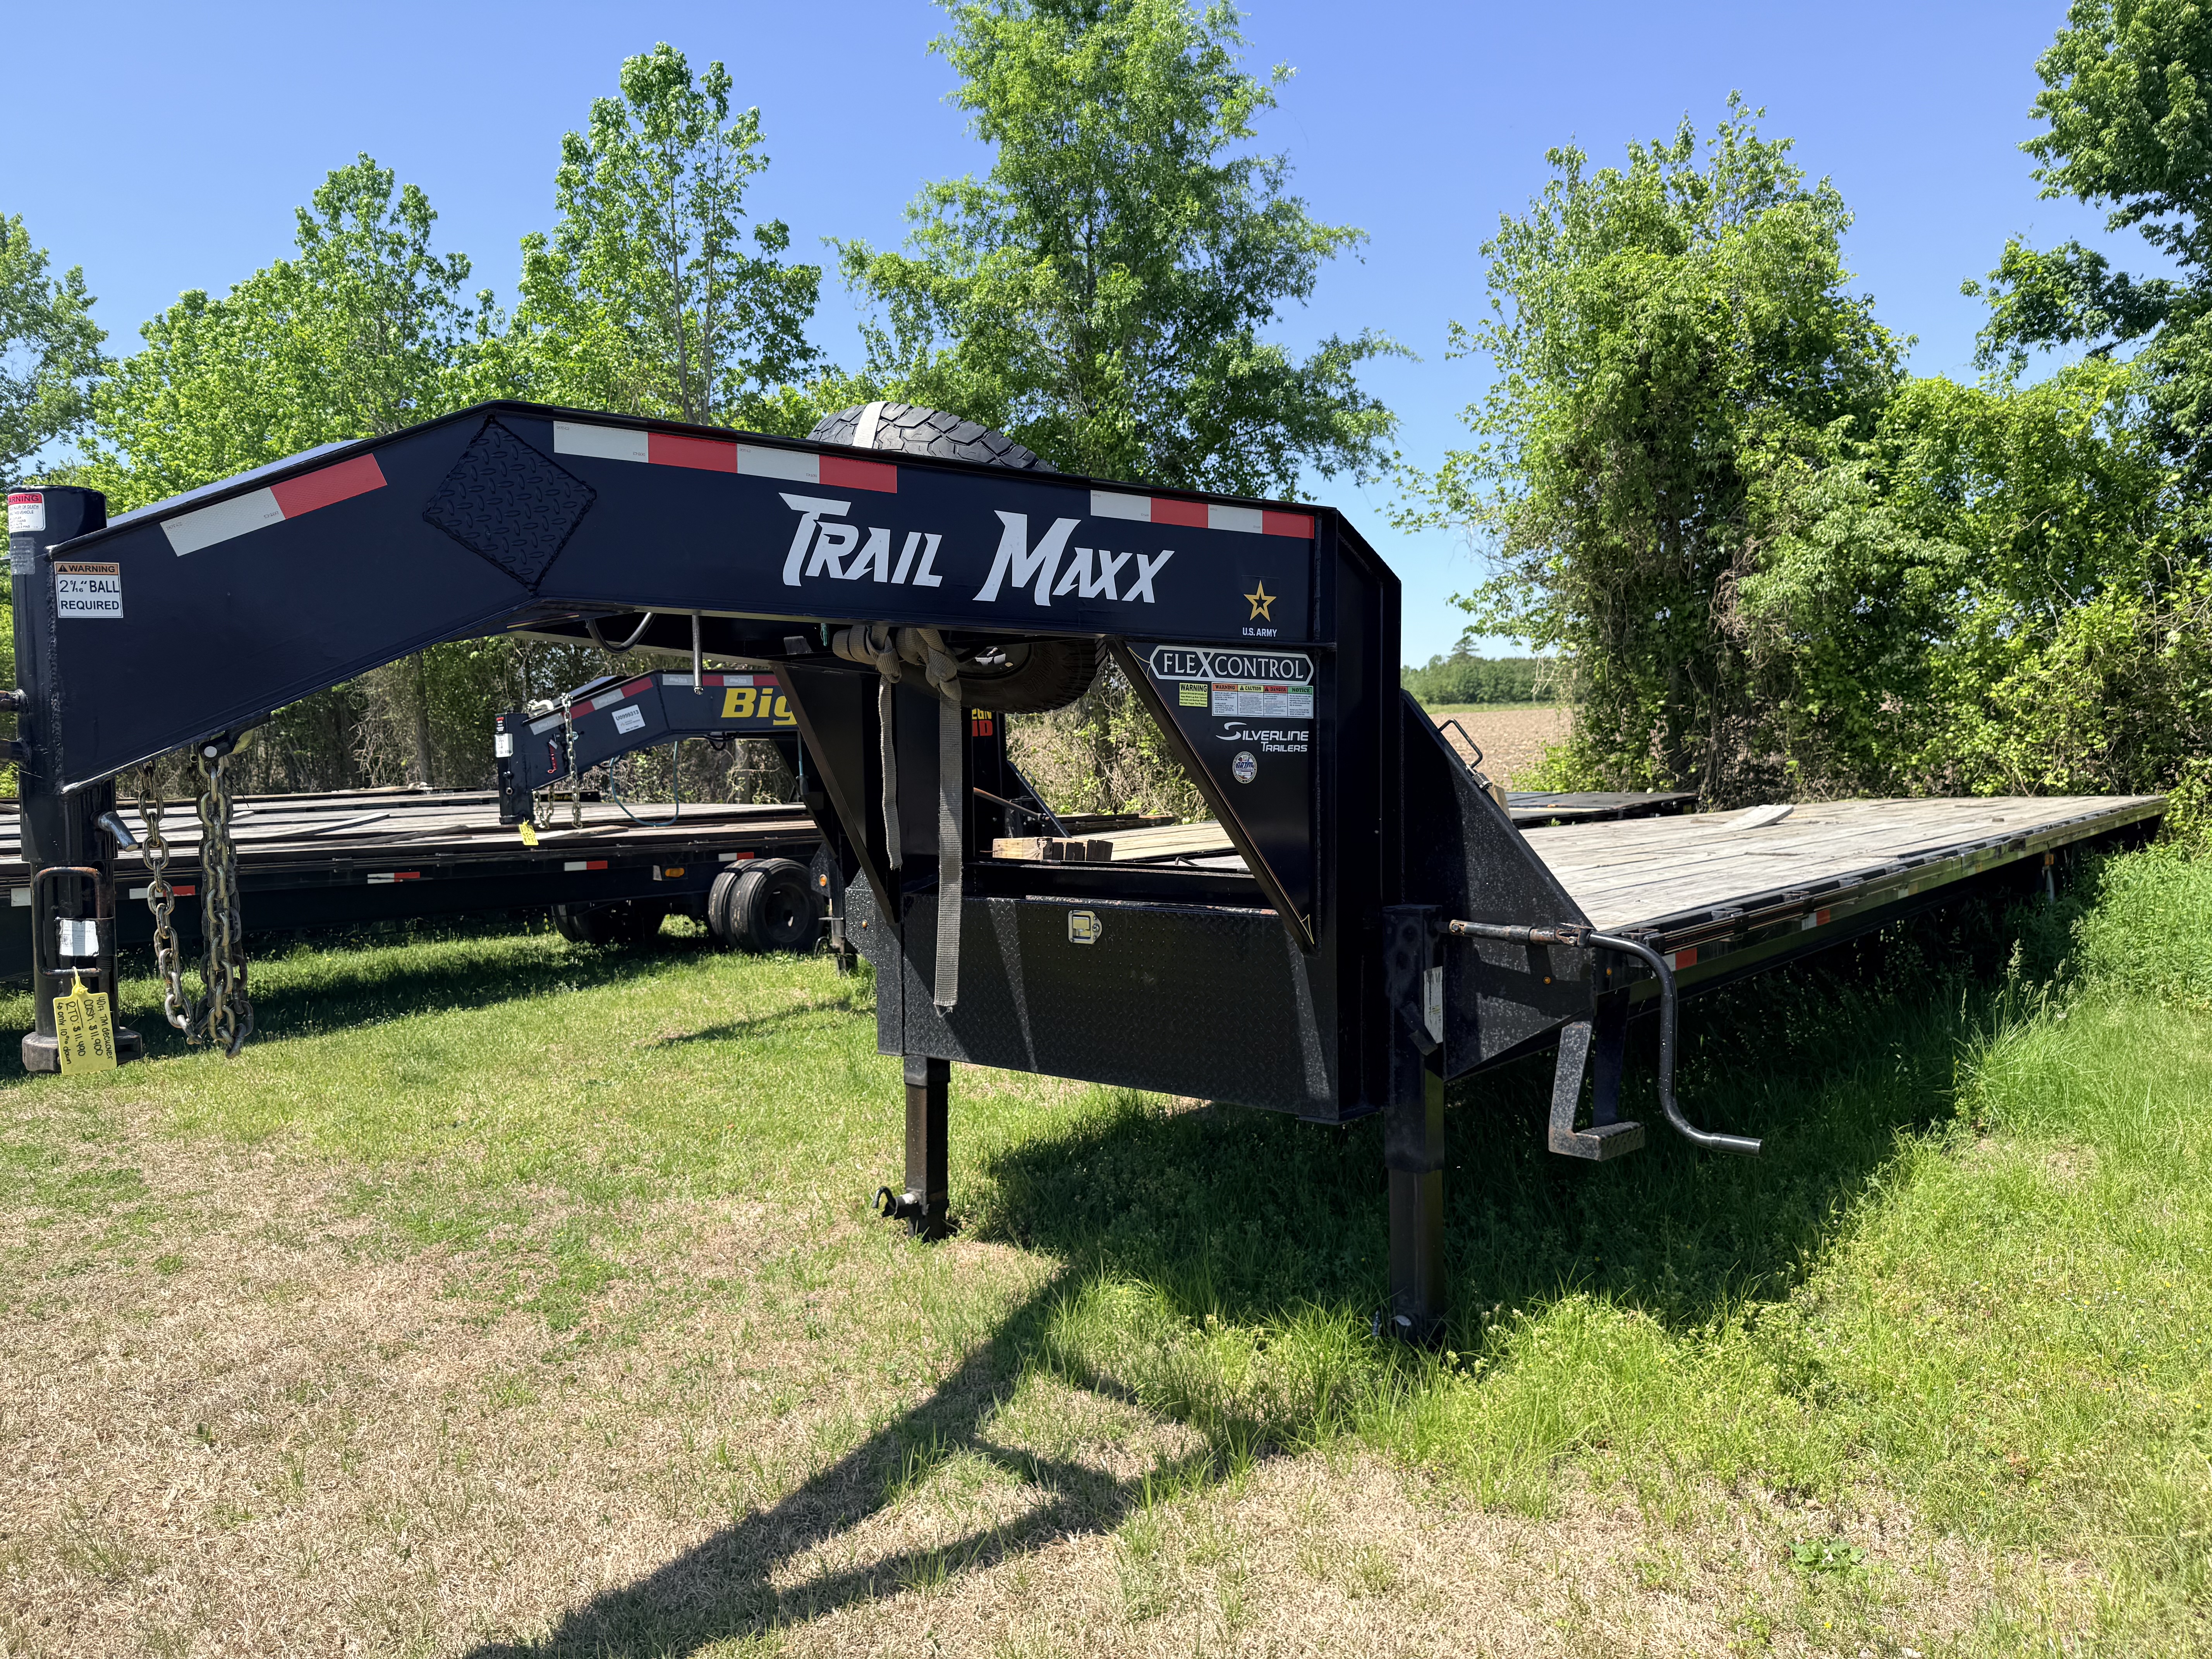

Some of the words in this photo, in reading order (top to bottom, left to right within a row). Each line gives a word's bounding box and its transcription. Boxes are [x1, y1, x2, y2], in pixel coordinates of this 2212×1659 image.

[9, 495, 39, 503] ARNING
[778, 493, 943, 587] TRAIL
[972, 510, 1175, 606] MAXX
[89, 580, 119, 592] BALL
[61, 600, 119, 610] REQUIRED
[1242, 627, 1255, 636] U.S.
[1256, 628, 1277, 637] ARMY
[1180, 684, 1207, 692] WARNING
[721, 688, 798, 725] Big
[1216, 722, 1309, 741] SILVERLINE
[1261, 741, 1308, 752] TRAILERS
[58, 1012, 66, 1025] only
[100, 1014, 108, 1026] TM
[60, 1029, 69, 1044] 10%
[63, 1046, 71, 1065] down
